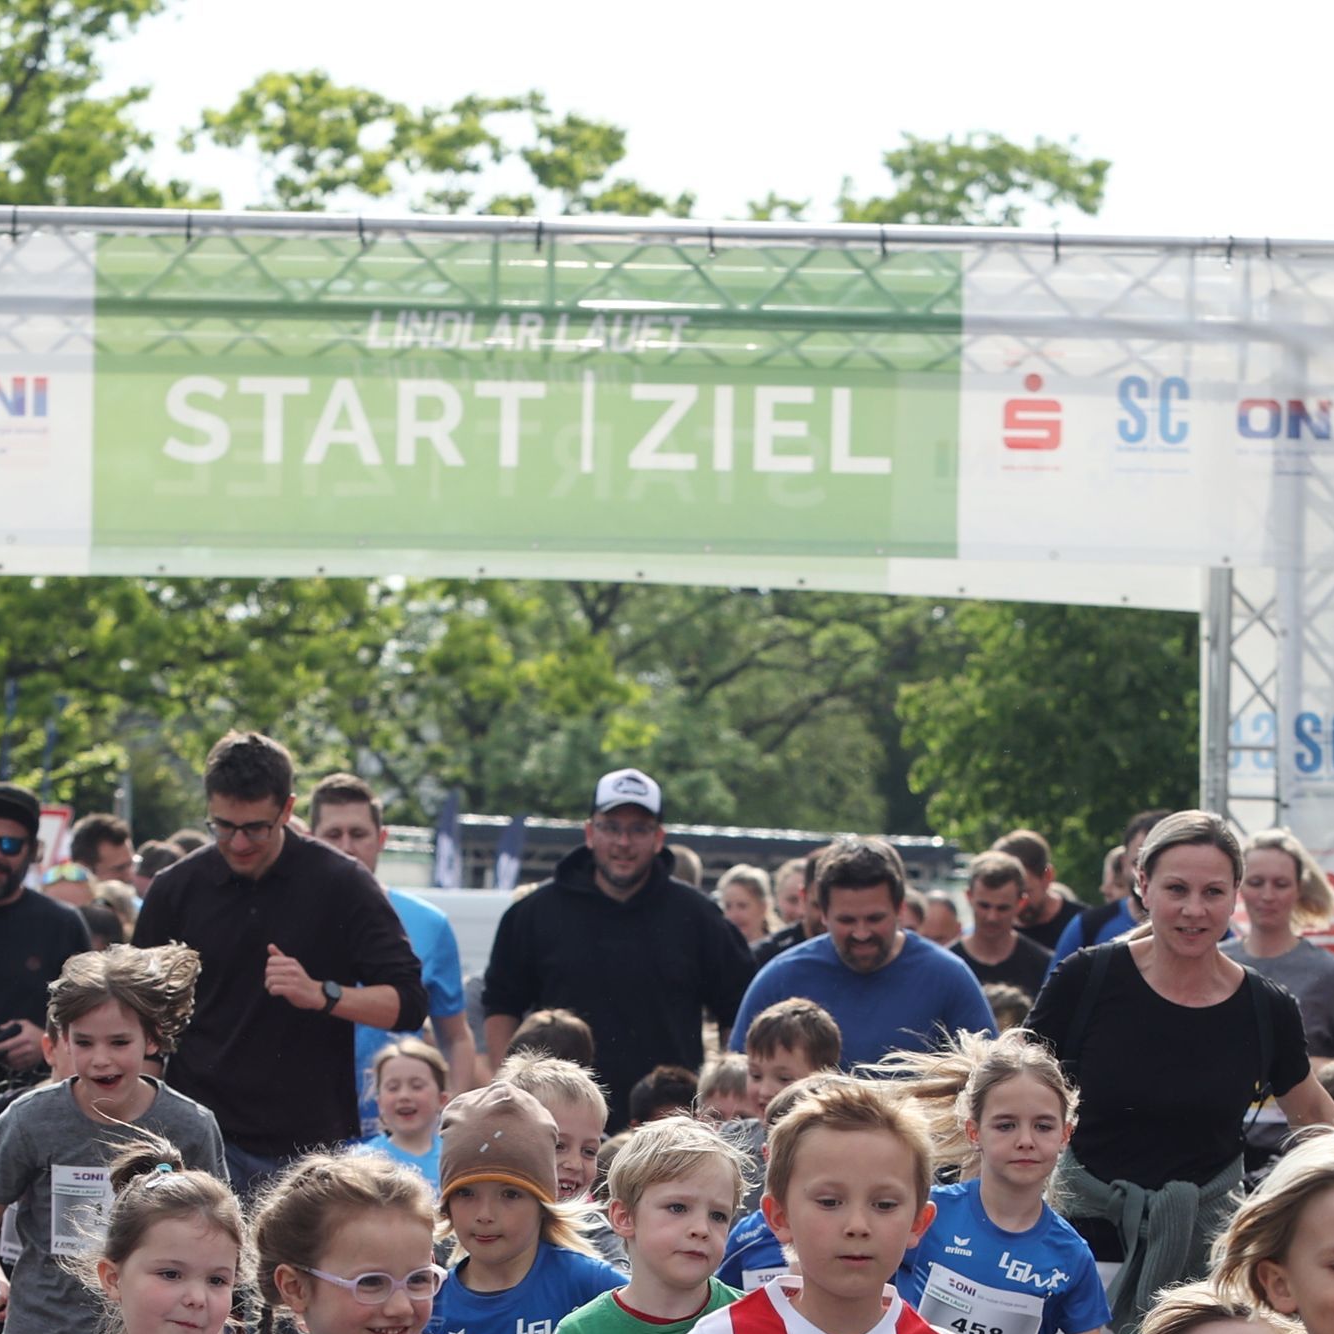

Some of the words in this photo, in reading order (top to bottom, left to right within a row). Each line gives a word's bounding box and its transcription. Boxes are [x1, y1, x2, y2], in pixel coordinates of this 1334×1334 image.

[1116, 375, 1190, 445] SC
[162, 375, 546, 468] START
[628, 382, 892, 475] ZIEL
[82, 1172, 104, 1181] ONI
[944, 1245, 973, 1257] erima
[998, 1251, 1051, 1288] LGW
[955, 1281, 977, 1298] ONI
